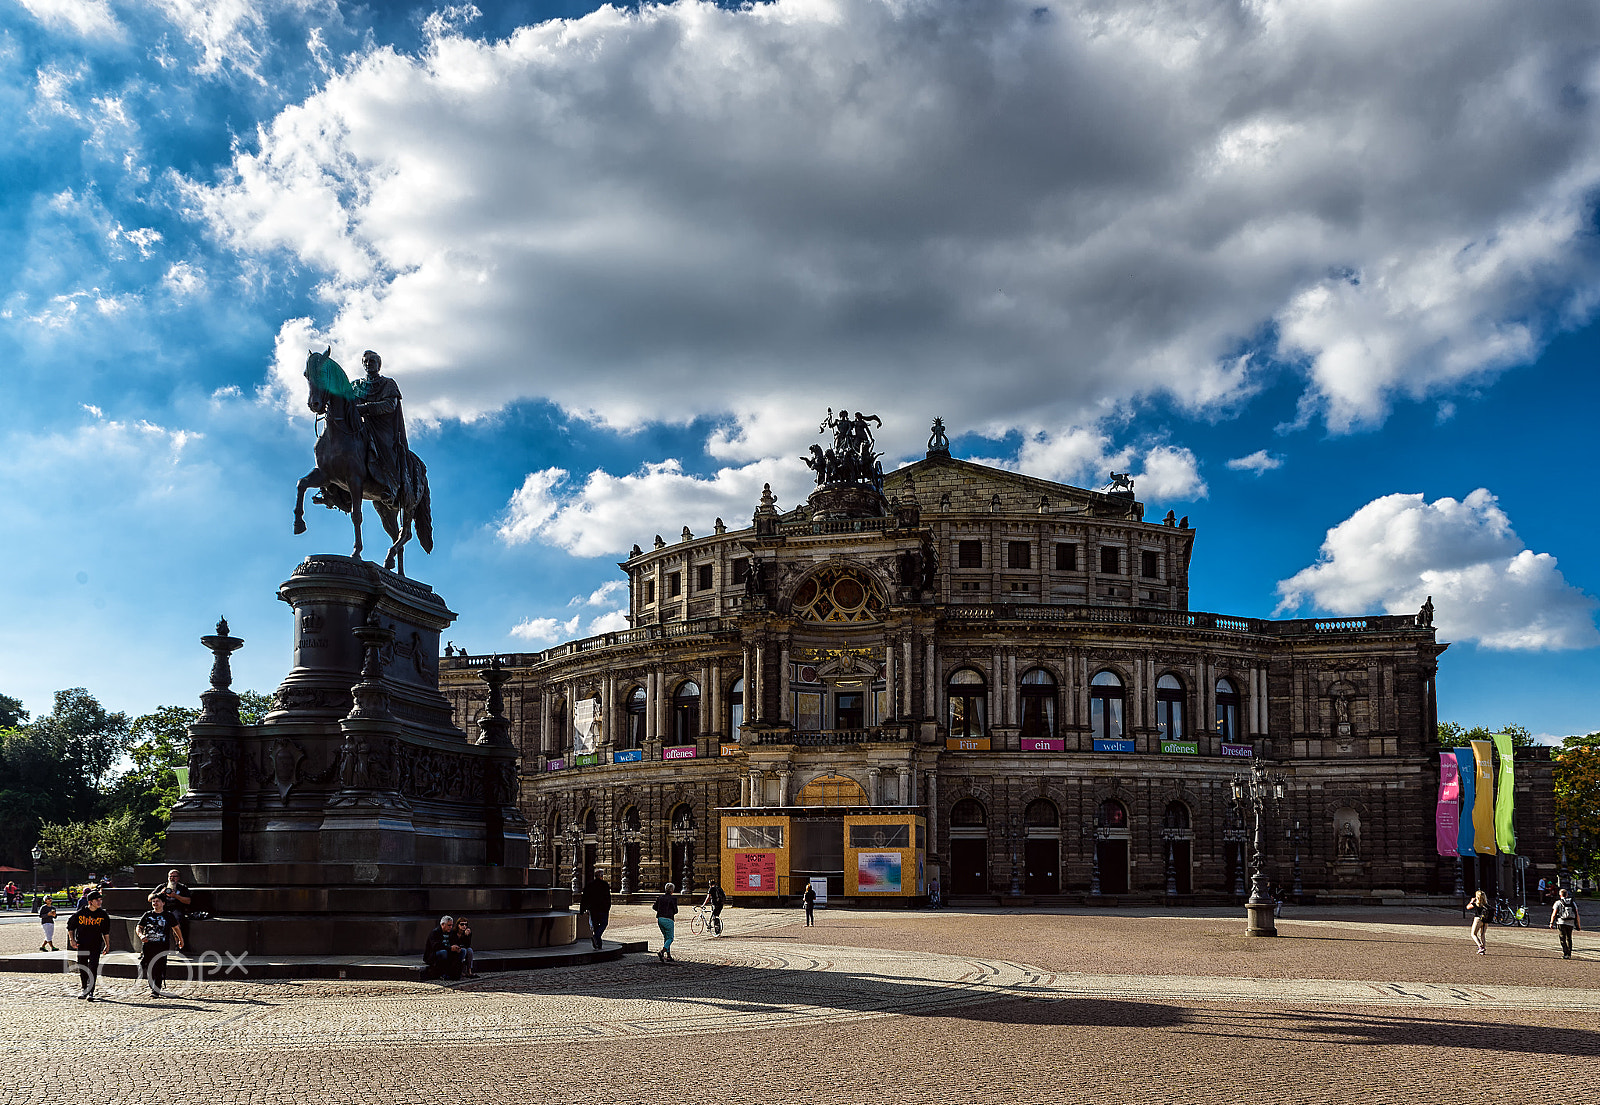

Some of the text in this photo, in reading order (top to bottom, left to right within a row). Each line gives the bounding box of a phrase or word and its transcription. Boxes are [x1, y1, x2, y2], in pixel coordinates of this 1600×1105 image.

[666, 749, 694, 759] offenes
[959, 740, 1253, 757] Für ein welt- offenes Dresden
